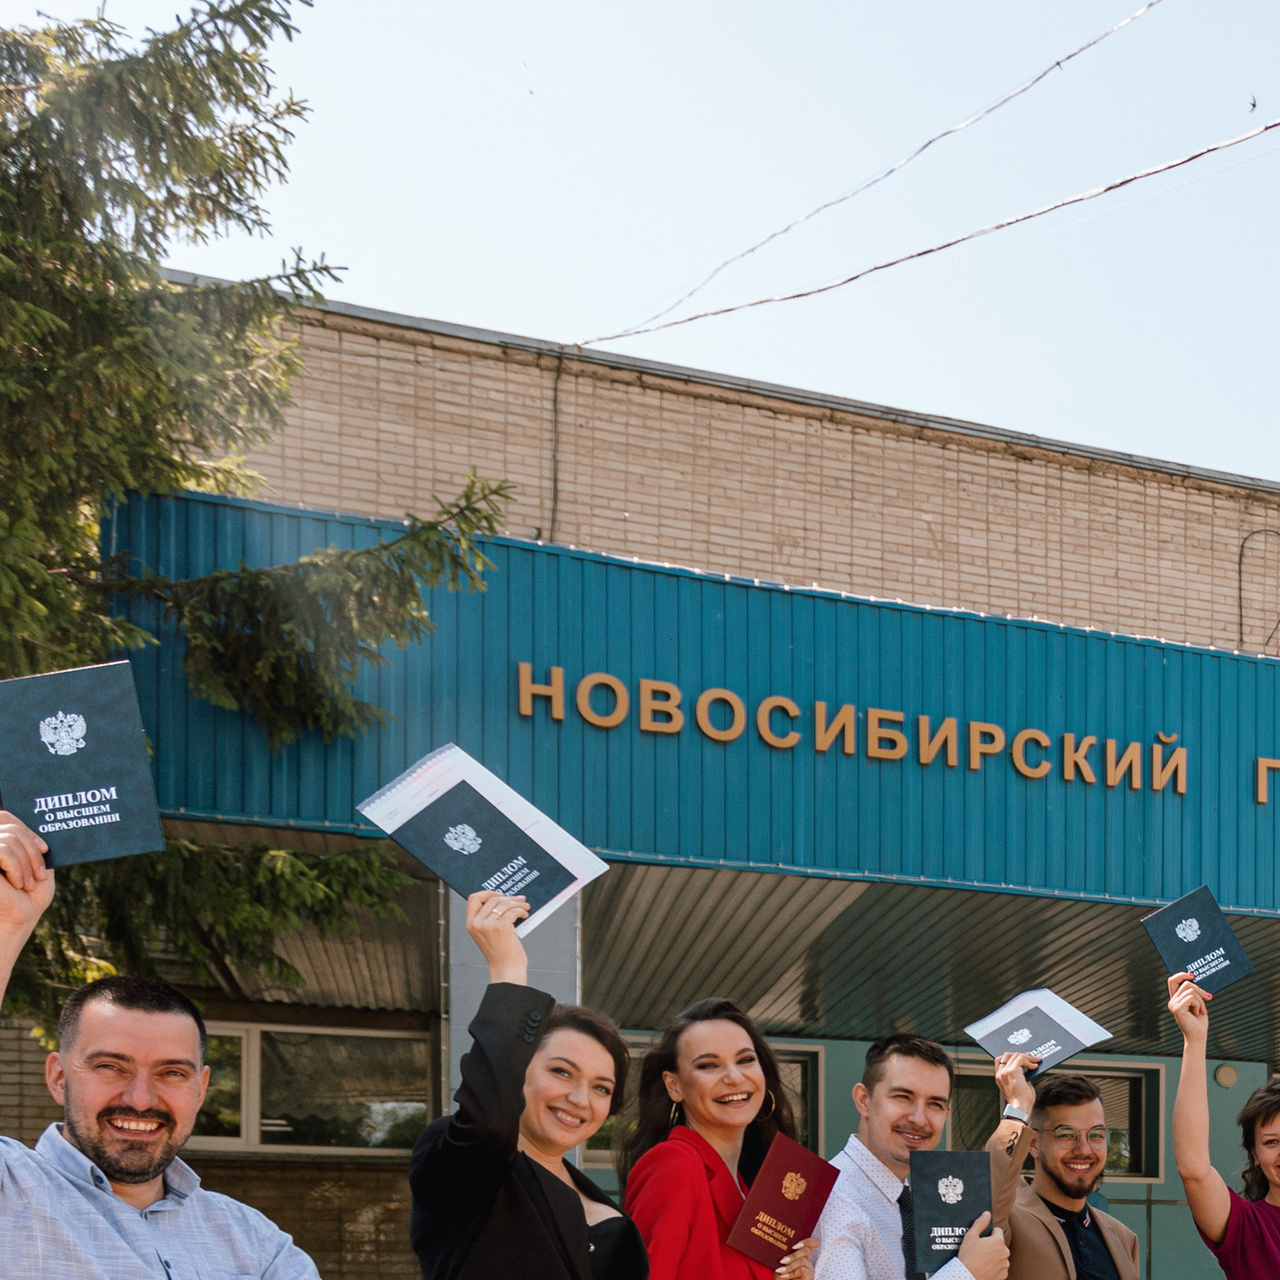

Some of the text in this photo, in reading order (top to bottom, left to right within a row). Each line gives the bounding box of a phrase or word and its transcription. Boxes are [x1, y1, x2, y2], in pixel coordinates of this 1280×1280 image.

[518, 661, 1187, 794] НОВОСИБИРСКИЙ
[34, 787, 118, 814] ДИПЛОМ
[45, 803, 111, 822] О ВЫСШЕМ
[38, 813, 121, 834] ОБРАЗОВАНИИ
[481, 855, 528, 891] ДИПЛОМ
[1186, 946, 1225, 974] ДИПЛОМ
[754, 1210, 796, 1239] ДИПЛОМ
[930, 1227, 969, 1237] ДИПЛО
